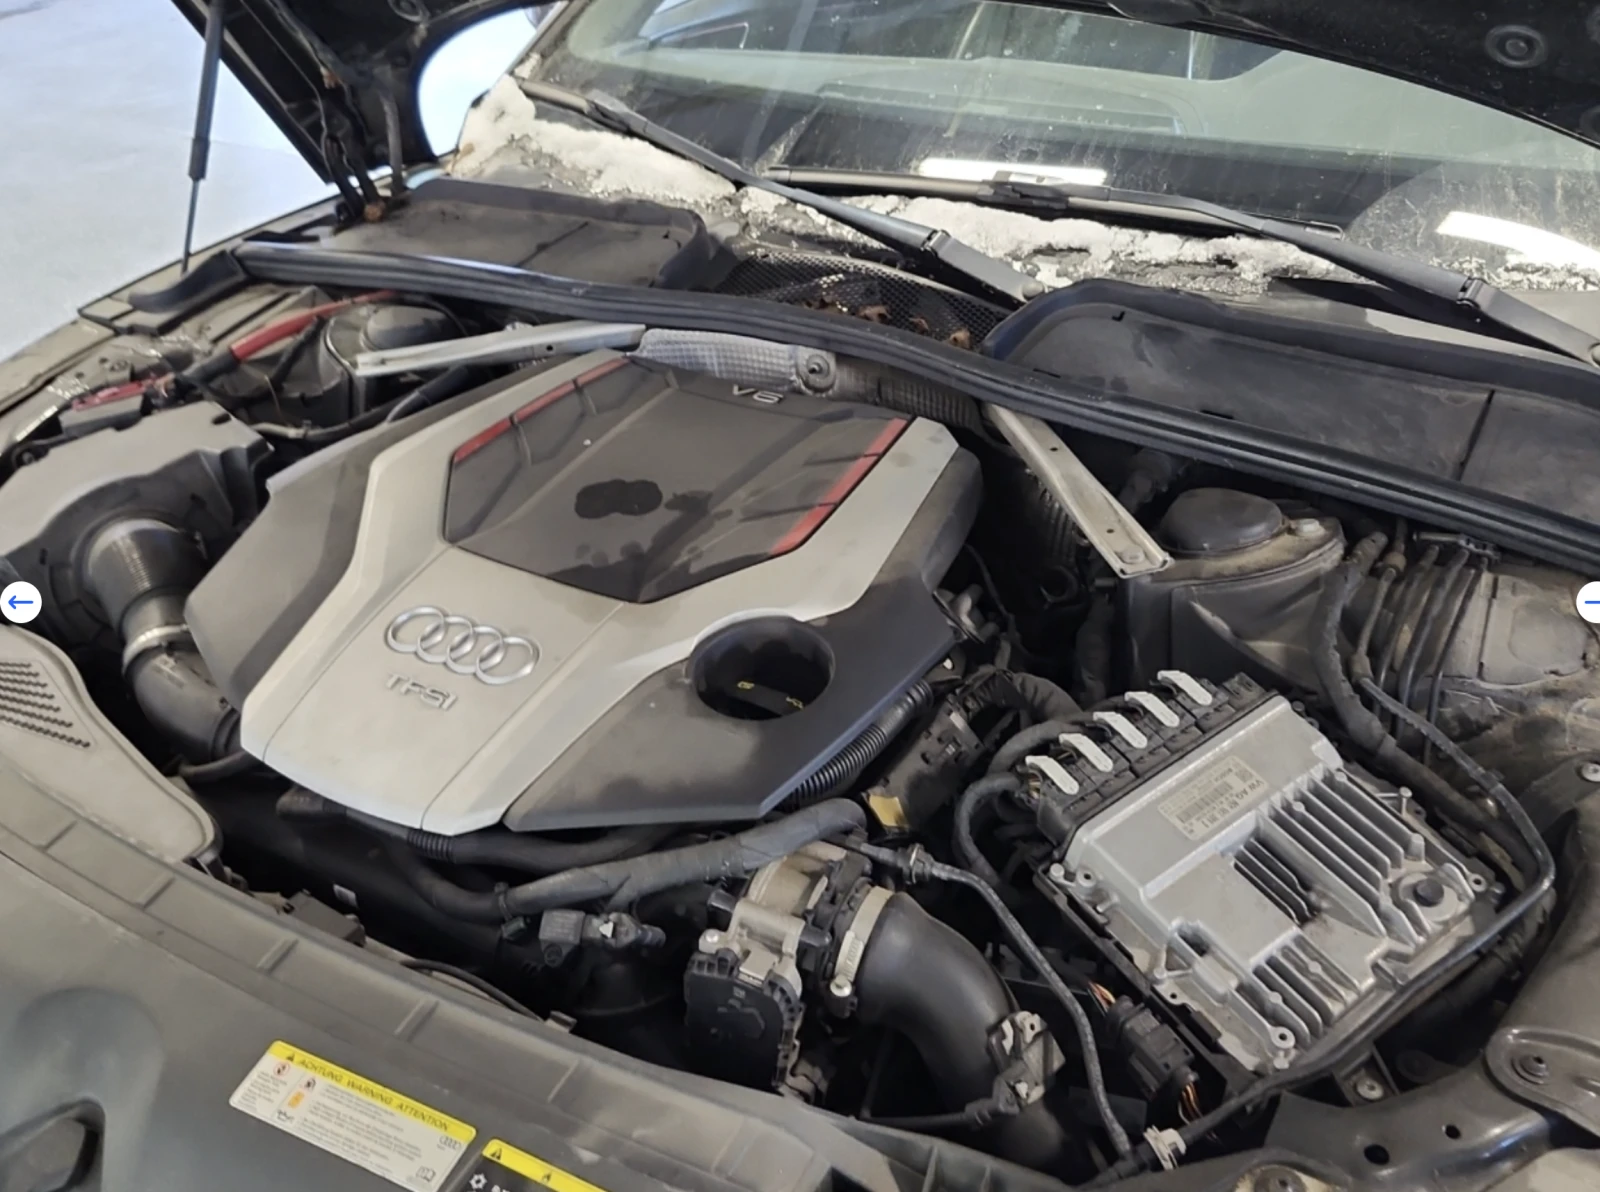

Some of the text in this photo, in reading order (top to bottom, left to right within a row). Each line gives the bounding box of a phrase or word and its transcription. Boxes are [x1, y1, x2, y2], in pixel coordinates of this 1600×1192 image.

[733, 384, 784, 404] V6
[386, 673, 459, 711] TFSI
[300, 1059, 343, 1083] ACHTUNG
[346, 1078, 394, 1105] WARNING
[396, 1102, 449, 1132] ATTENTION
